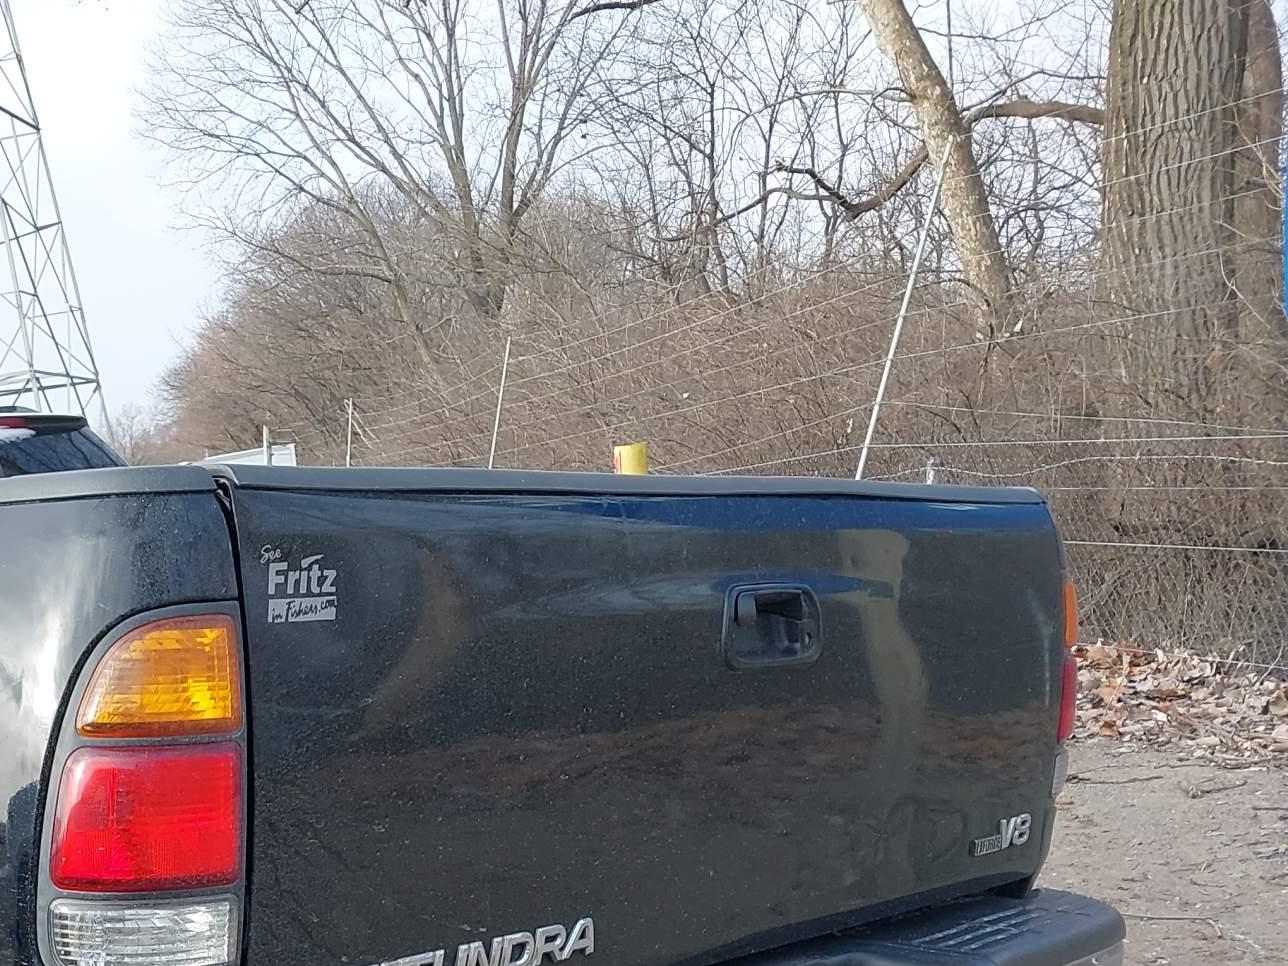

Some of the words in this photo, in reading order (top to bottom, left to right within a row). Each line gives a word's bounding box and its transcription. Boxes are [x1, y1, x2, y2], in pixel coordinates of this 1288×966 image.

[260, 544, 282, 564] See
[267, 554, 337, 595] Fritz
[999, 813, 1032, 850] V8
